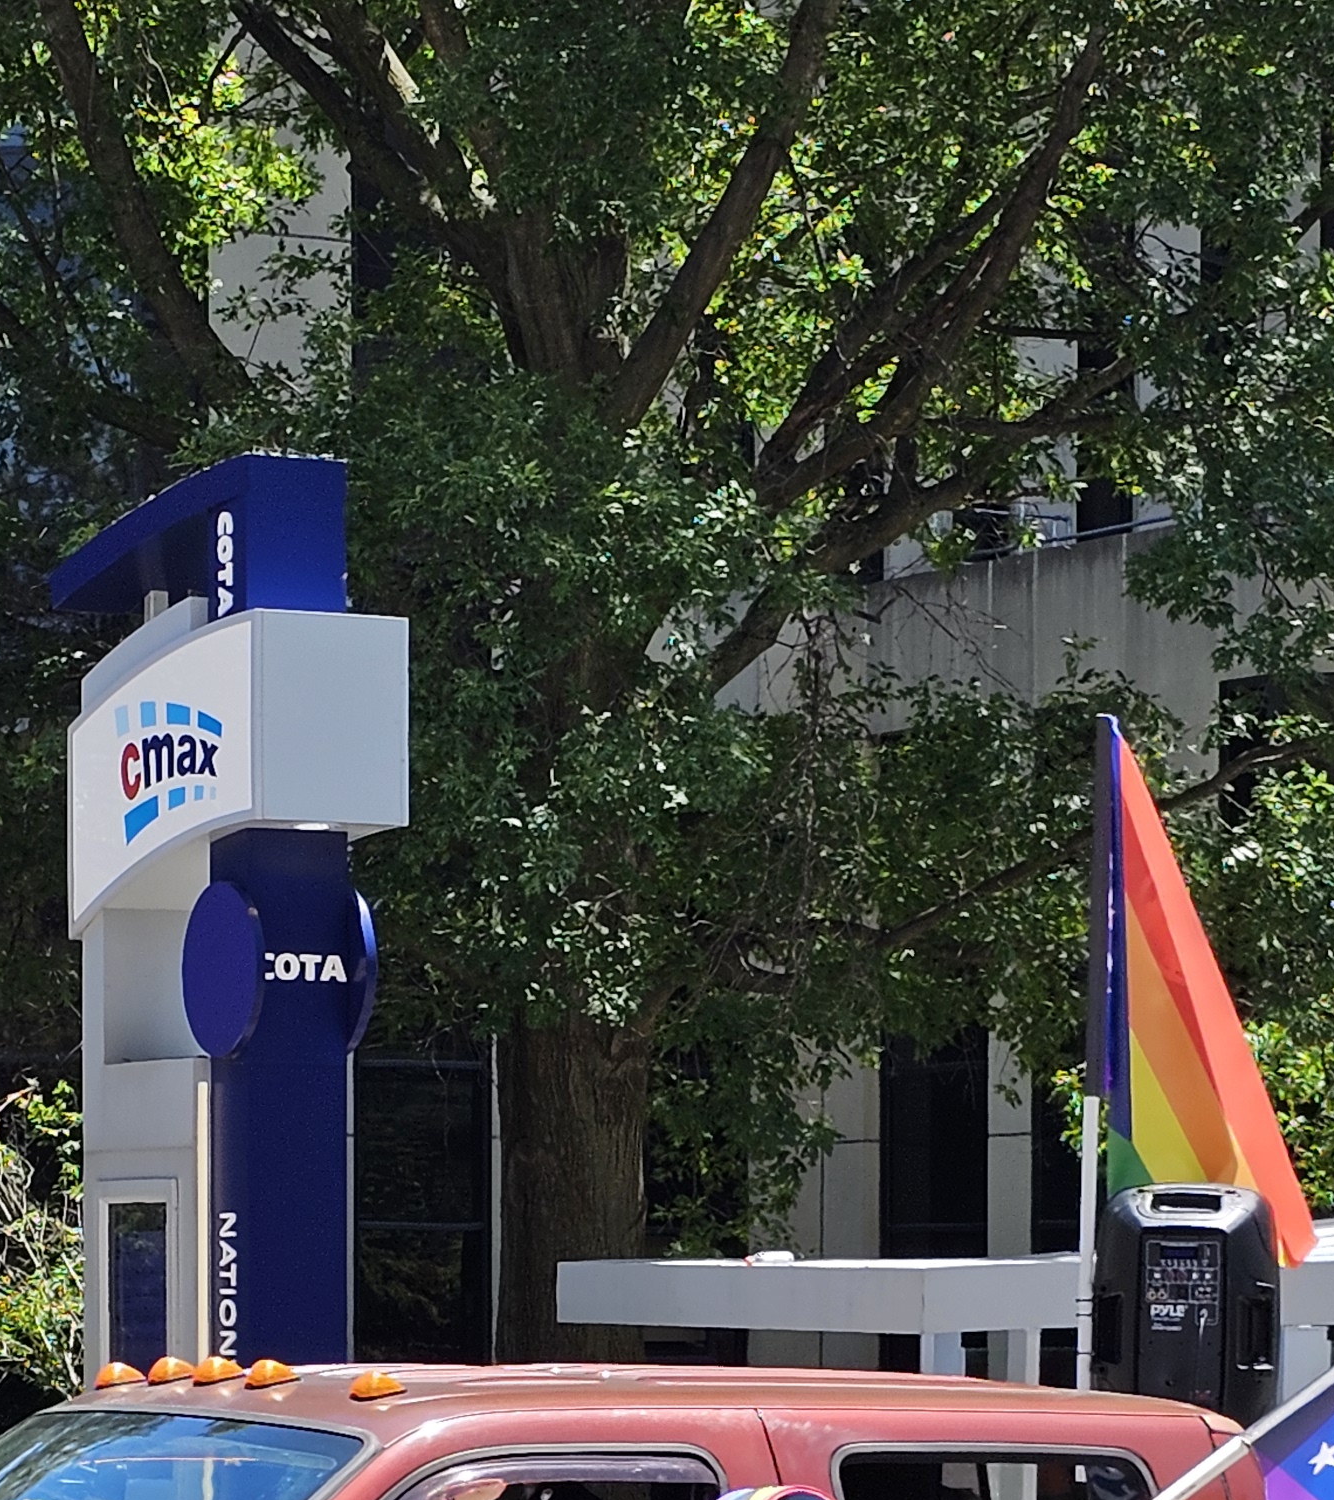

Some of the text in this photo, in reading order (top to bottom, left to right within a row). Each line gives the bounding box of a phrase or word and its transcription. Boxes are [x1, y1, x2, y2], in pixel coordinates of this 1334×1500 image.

[217, 511, 234, 617] COTA
[120, 732, 220, 801] cmax
[219, 1212, 238, 1356] NATION
[1150, 1304, 1185, 1318] PYLE
